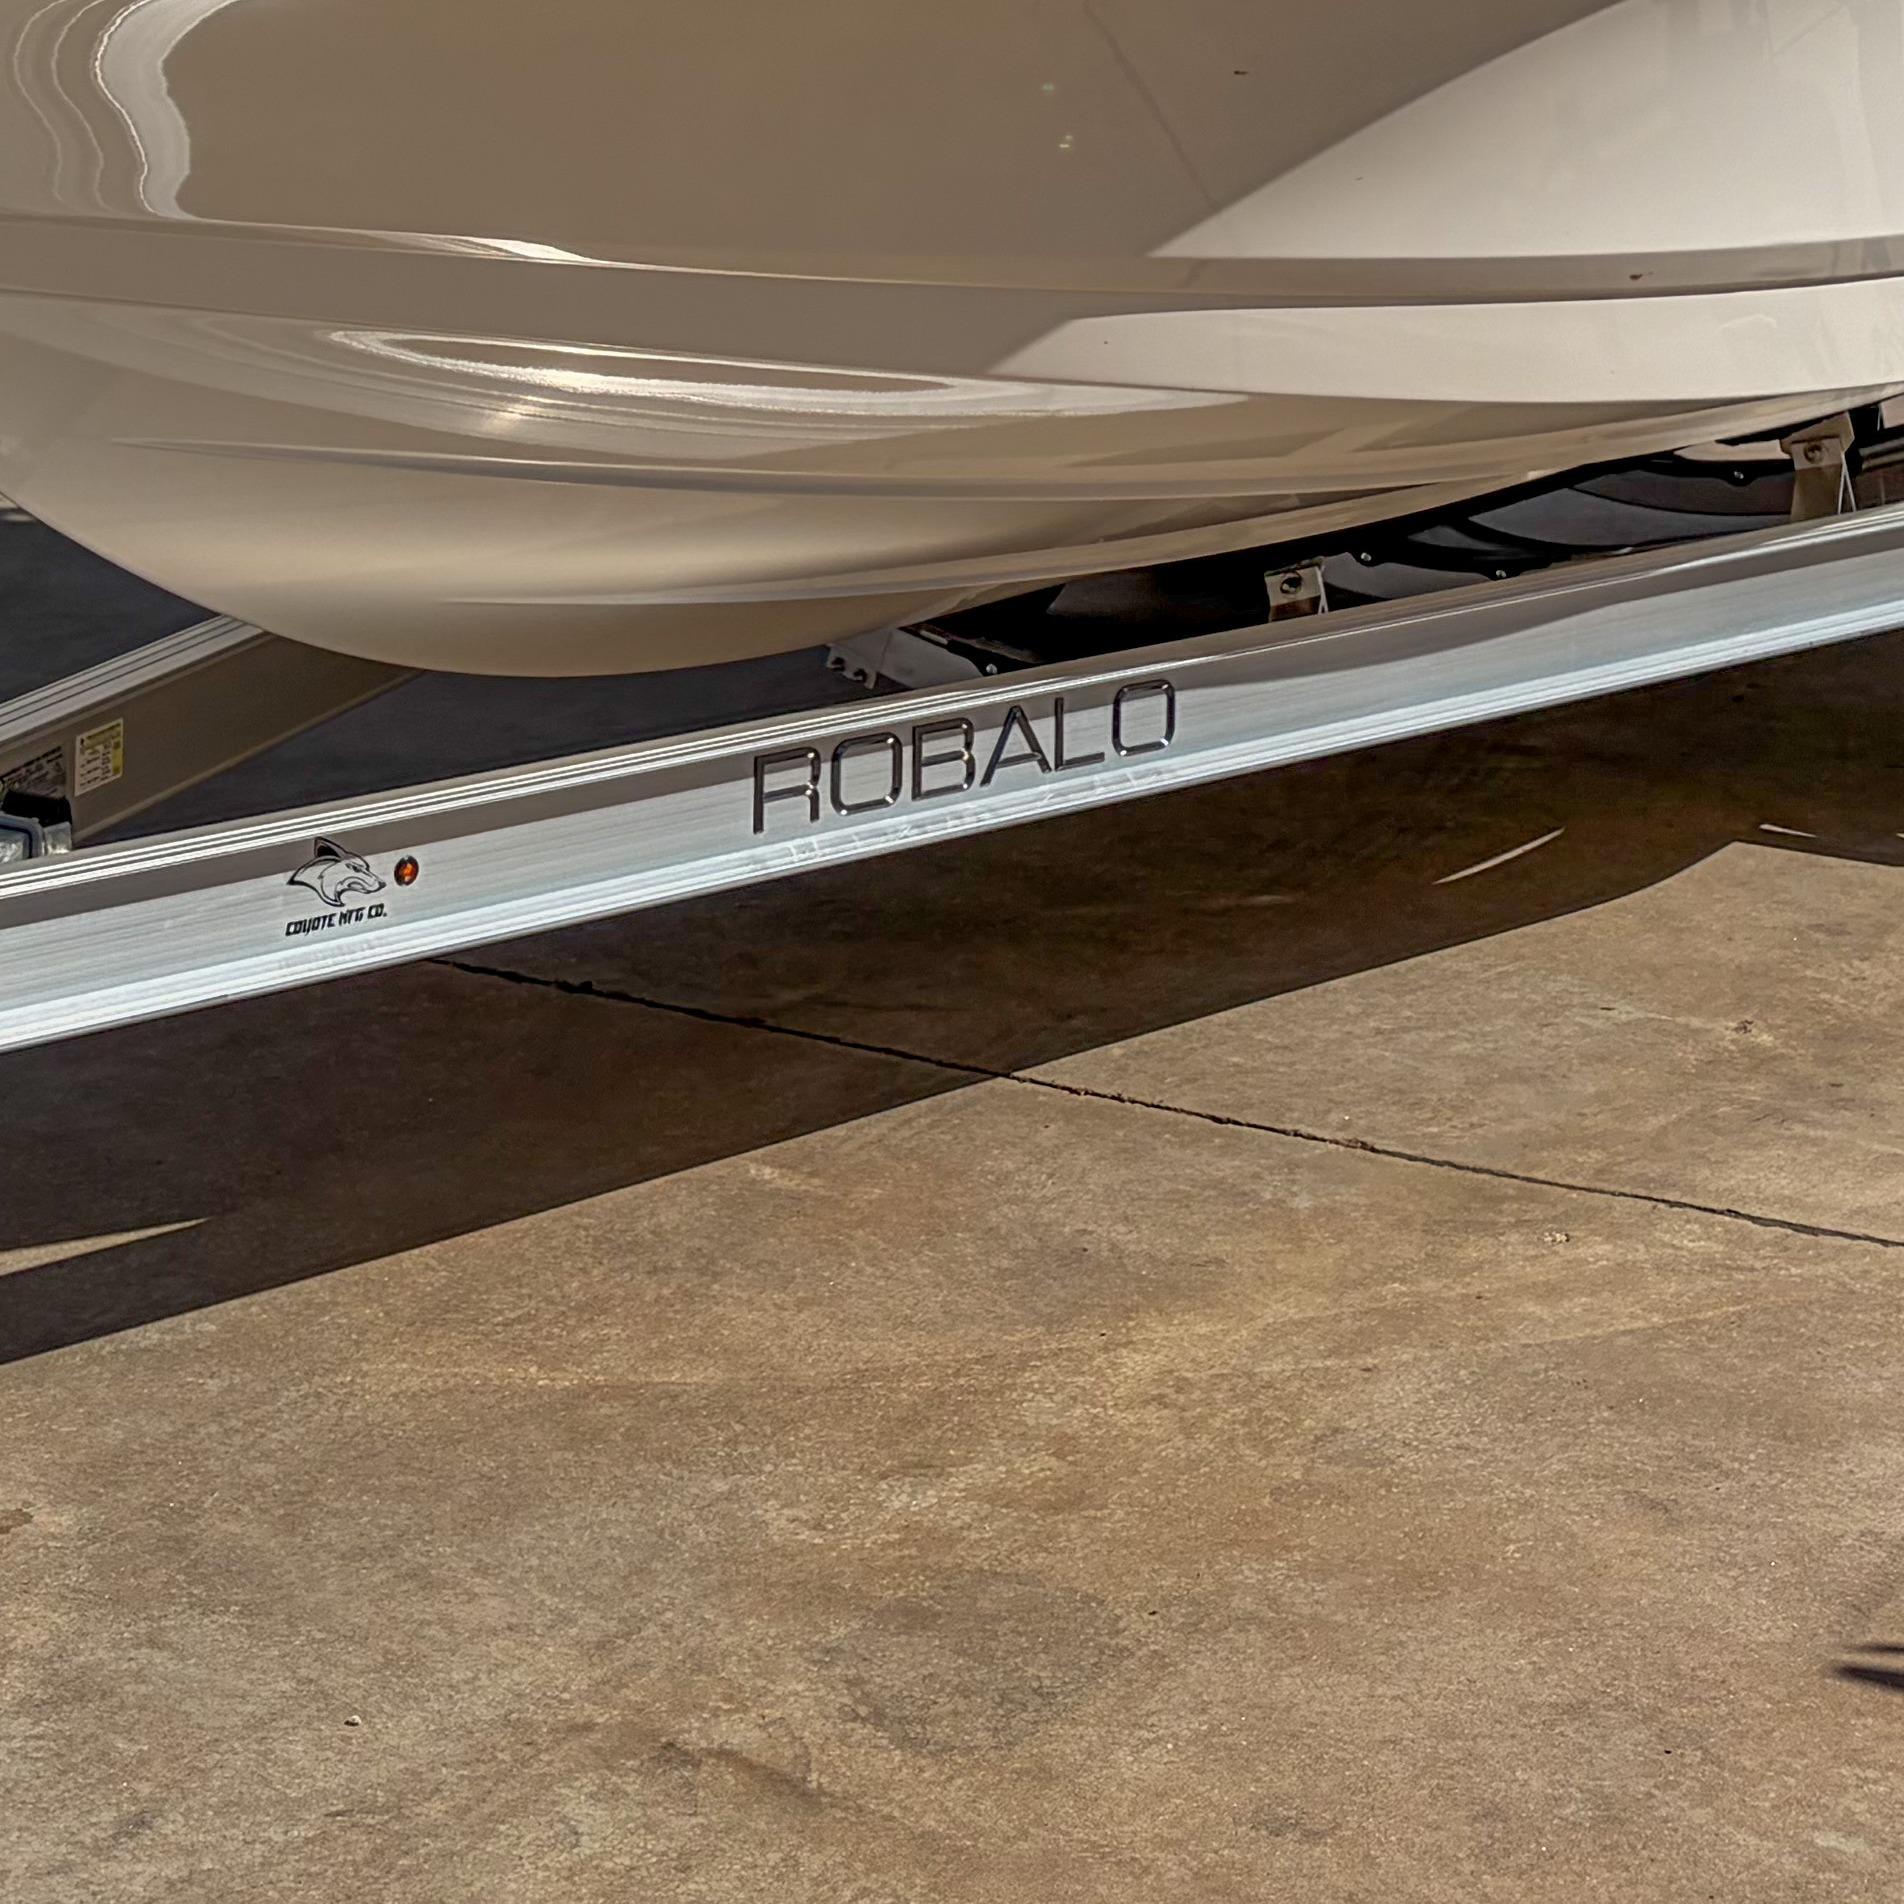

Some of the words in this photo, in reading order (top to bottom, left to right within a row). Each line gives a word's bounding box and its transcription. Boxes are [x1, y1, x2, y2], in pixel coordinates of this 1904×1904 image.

[753, 678, 1176, 834] ROBALO
[284, 912, 337, 937] COYOTE
[367, 902, 388, 920] CO.
